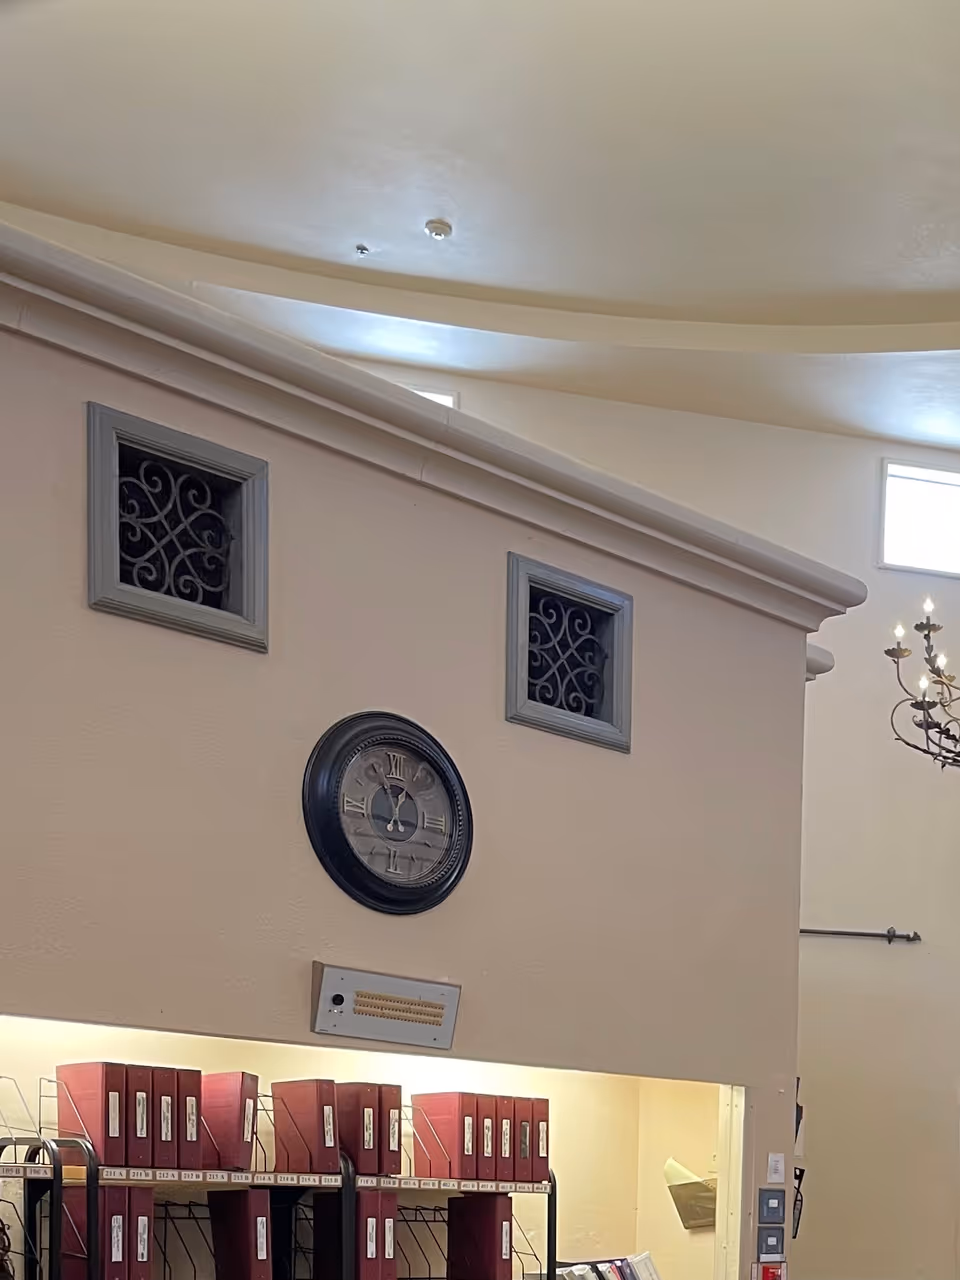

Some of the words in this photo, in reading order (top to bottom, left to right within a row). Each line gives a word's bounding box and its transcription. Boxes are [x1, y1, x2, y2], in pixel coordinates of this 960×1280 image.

[386, 752, 406, 782] XII
[343, 793, 366, 817] IX
[423, 811, 446, 833] III
